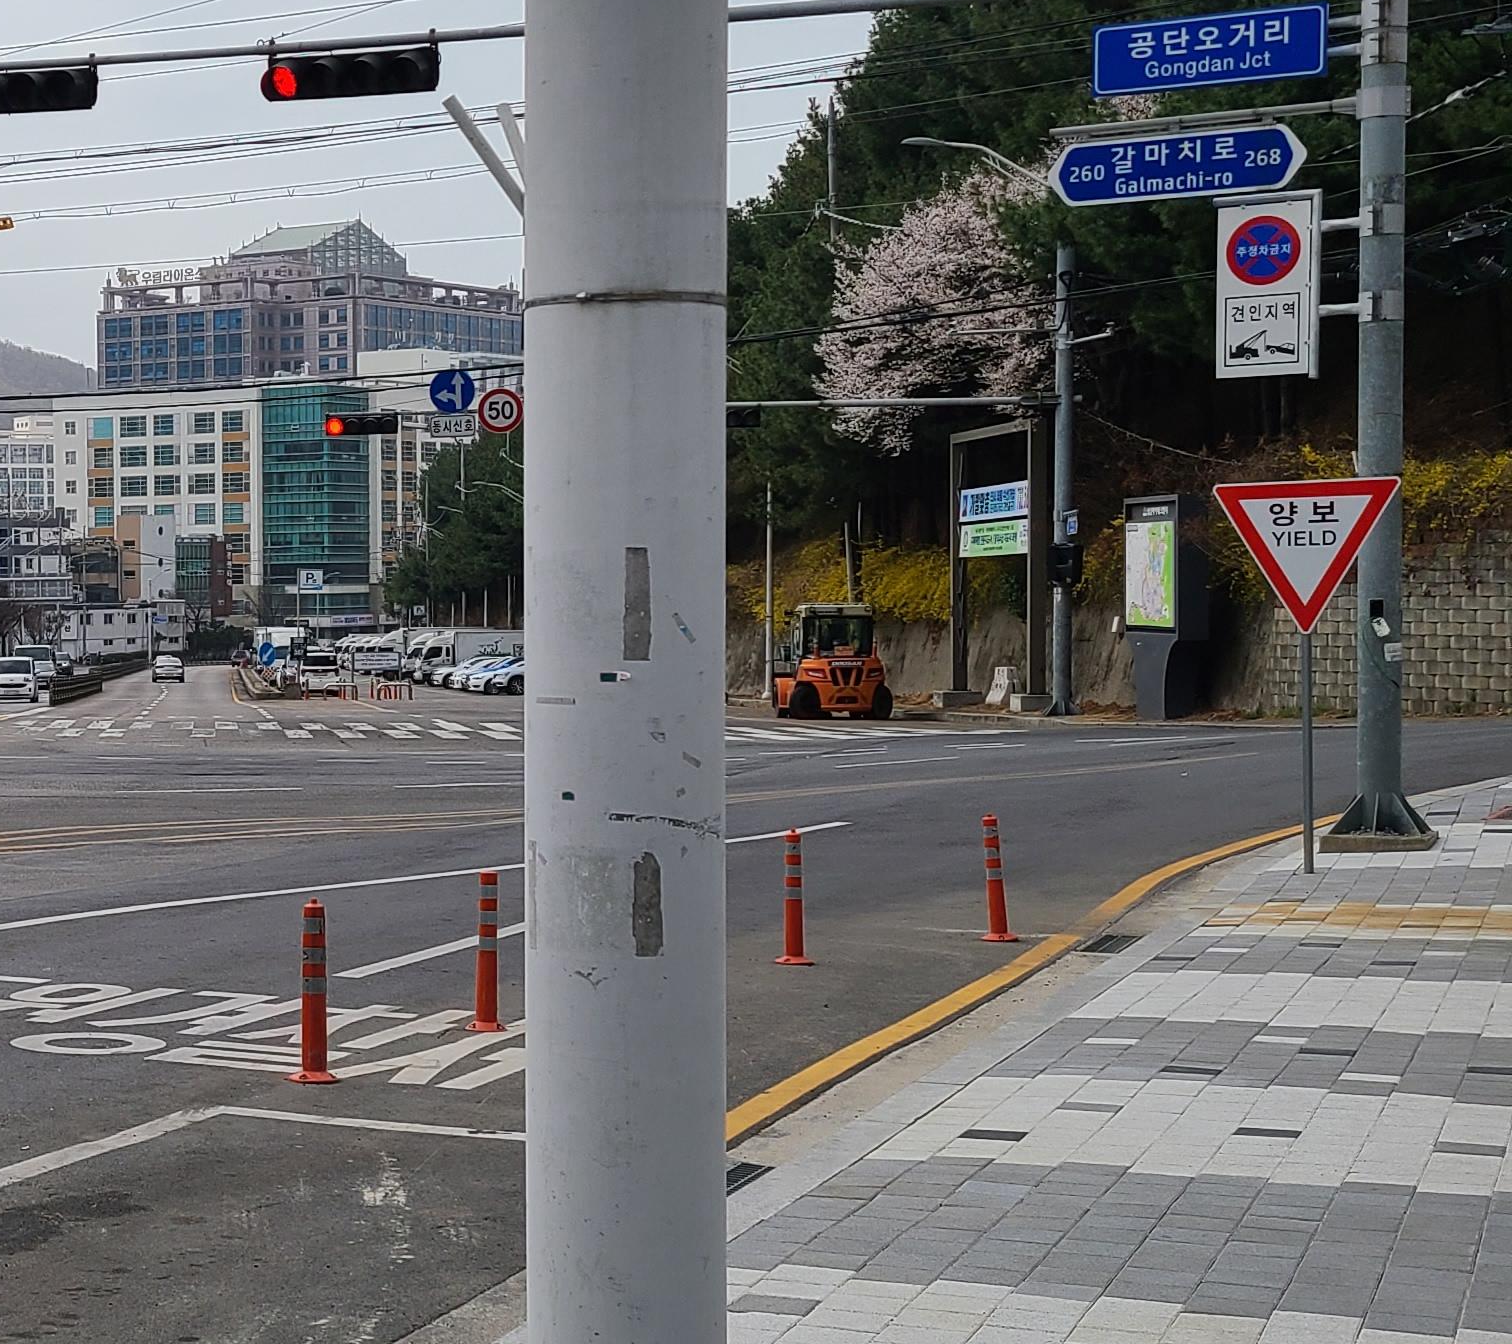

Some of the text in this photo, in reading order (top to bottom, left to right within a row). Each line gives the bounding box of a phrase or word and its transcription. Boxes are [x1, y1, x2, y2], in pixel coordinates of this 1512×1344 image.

[1127, 15, 1290, 60] 공단오거리
[1144, 50, 1272, 79] Gongdan Jct
[1069, 136, 1282, 183] 260 갈마치로 268
[1115, 170, 1234, 196] Galmachi-ro
[1236, 242, 1292, 259] 주정차금지
[1231, 301, 1296, 323] 견인지역
[487, 400, 514, 421] 50
[431, 419, 474, 434] 동시신호
[1269, 500, 1340, 527] 양보
[1271, 529, 1337, 547] YIELD
